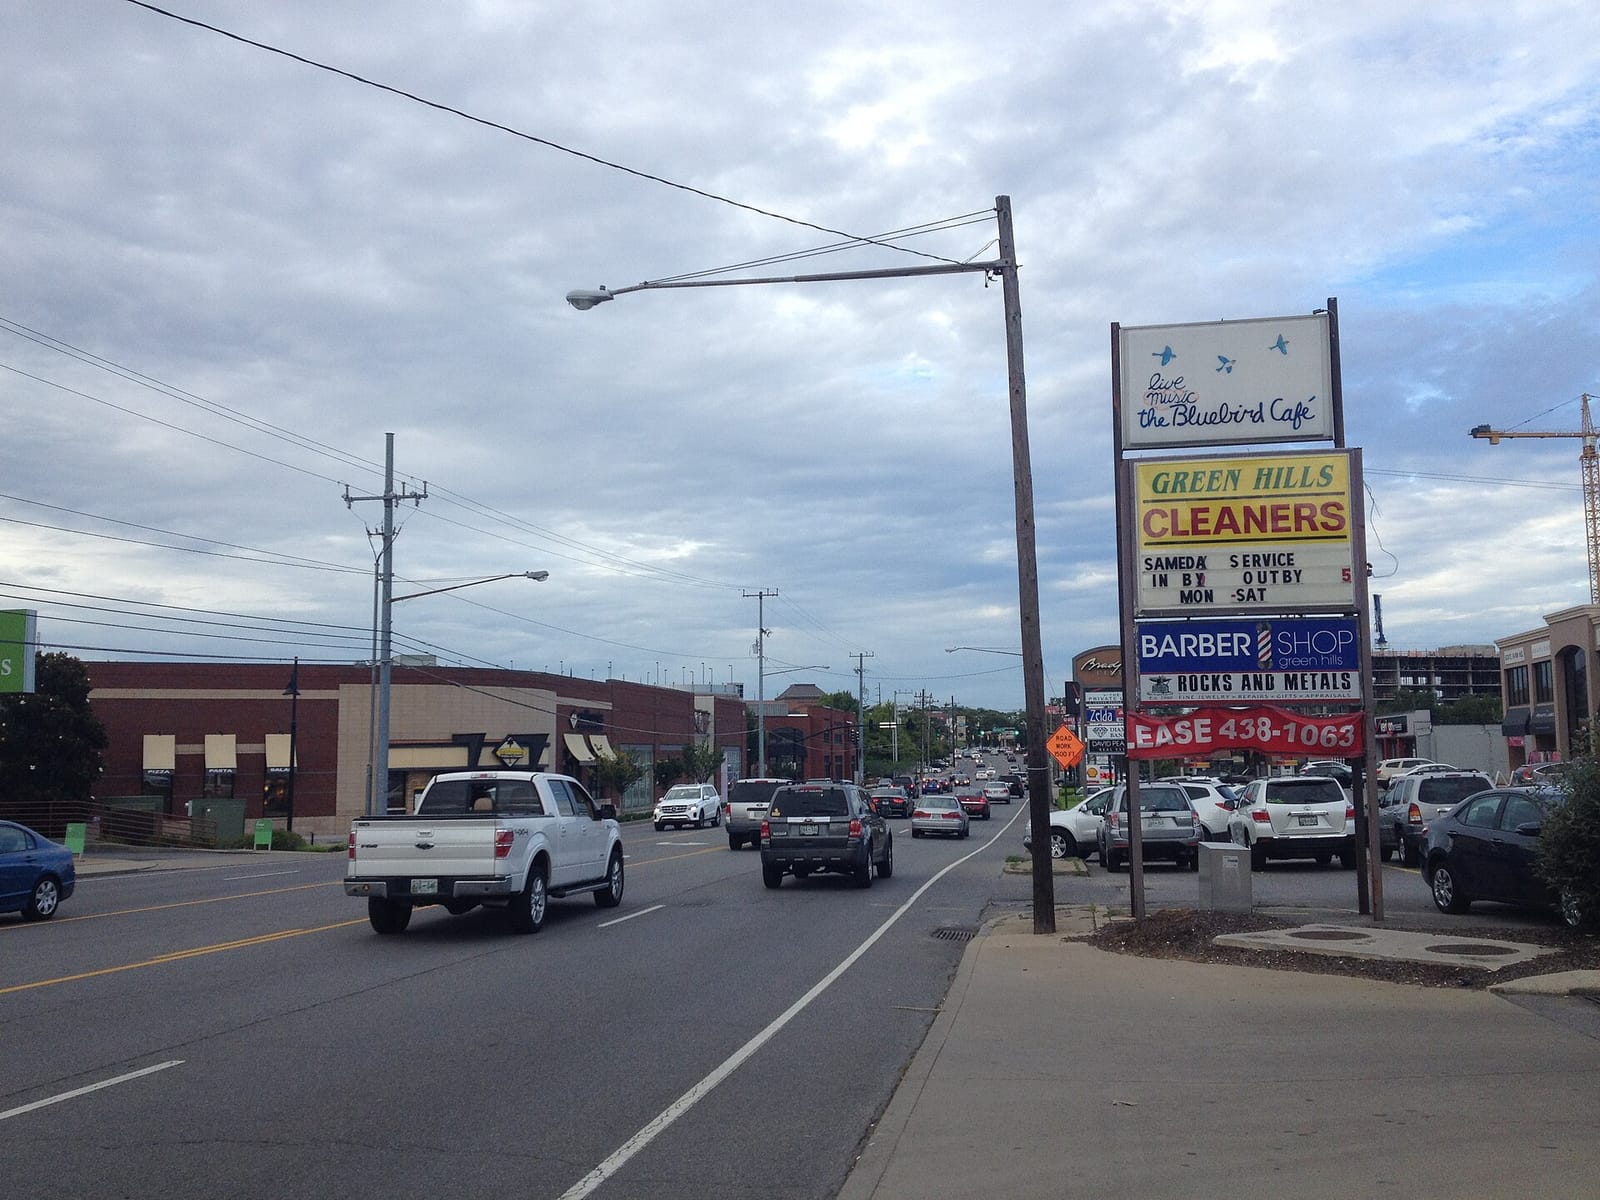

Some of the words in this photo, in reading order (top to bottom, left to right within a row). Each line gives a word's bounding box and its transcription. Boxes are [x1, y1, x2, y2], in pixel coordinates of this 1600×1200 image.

[1147, 372, 1186, 391] live
[1146, 389, 1198, 405] music
[1137, 407, 1171, 428] the
[1172, 401, 1264, 427] Bluebird
[1270, 395, 1316, 430] Café
[1152, 468, 1242, 494] GREEN
[1252, 464, 1334, 490] HILLS
[1143, 501, 1346, 538] CLEANERS
[1229, 552, 1295, 568] SERVICE
[1152, 574, 1168, 588] IN
[1341, 568, 1352, 583] 5
[1180, 589, 1214, 604] MON
[1141, 632, 1251, 658] BARBER
[1277, 630, 1354, 655] SHOP
[1278, 657, 1318, 670] green
[1321, 655, 1344, 665] hills
[1177, 673, 1232, 691] ROCKS
[1241, 673, 1275, 691] AND
[1284, 672, 1352, 691] METALS
[1090, 709, 1113, 722] Zelda
[1218, 716, 1356, 748] 438-1063
